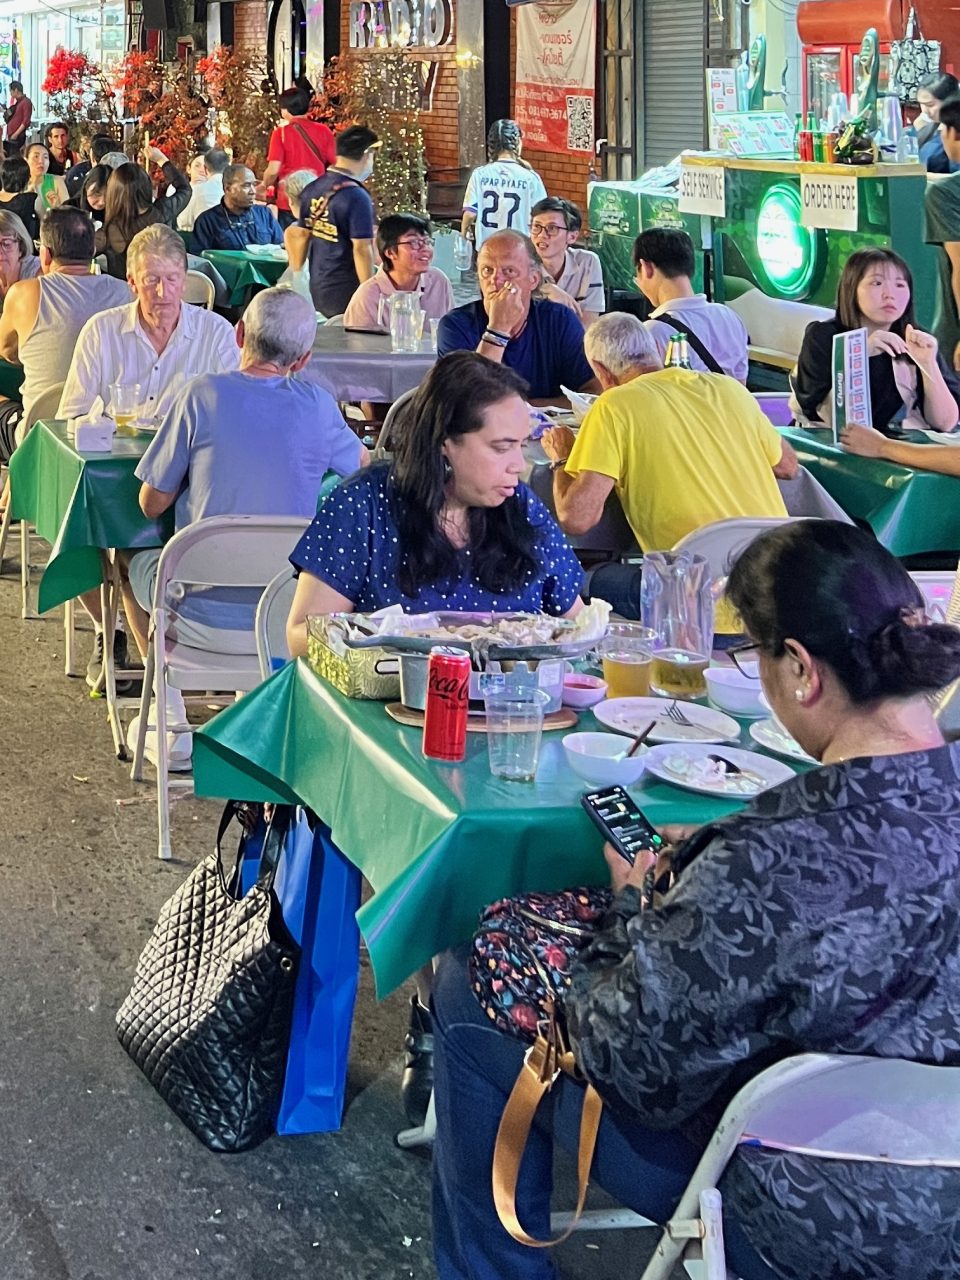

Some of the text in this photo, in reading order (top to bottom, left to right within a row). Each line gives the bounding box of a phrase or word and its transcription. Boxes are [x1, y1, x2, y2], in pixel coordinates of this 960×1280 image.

[682, 171, 723, 201] SELF SERVICE
[803, 182, 856, 211] ORDER HERE
[481, 190, 521, 229] 27
